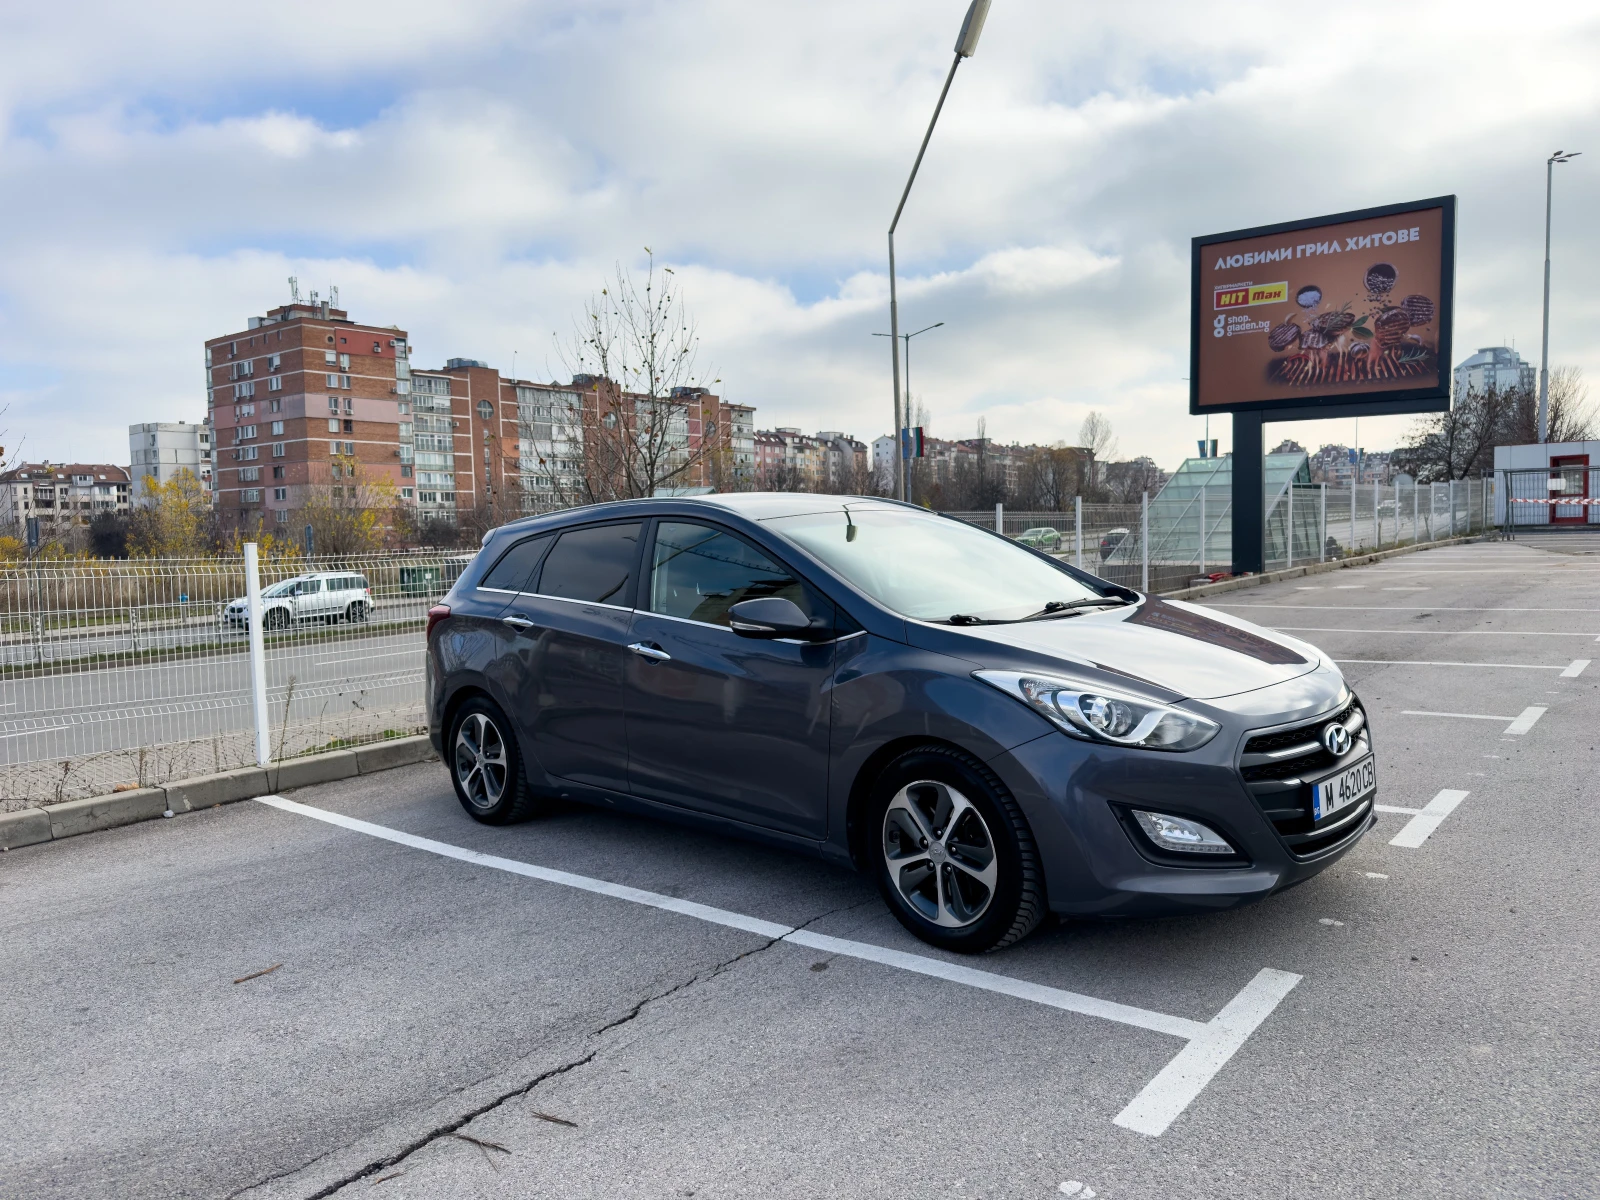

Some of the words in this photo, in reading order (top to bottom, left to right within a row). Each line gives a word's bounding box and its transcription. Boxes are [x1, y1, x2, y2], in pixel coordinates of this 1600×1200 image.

[1214, 246, 1292, 270] ЛЮБИМИ
[1296, 240, 1342, 259] ГРИЛ
[1345, 227, 1420, 251] ХИТОВЕ
[1220, 291, 1246, 305] HIT
[1227, 314, 1251, 324] shop.
[1226, 320, 1270, 337] gladen.bg
[1325, 782, 1334, 812] M
[1339, 768, 1362, 803] 4620
